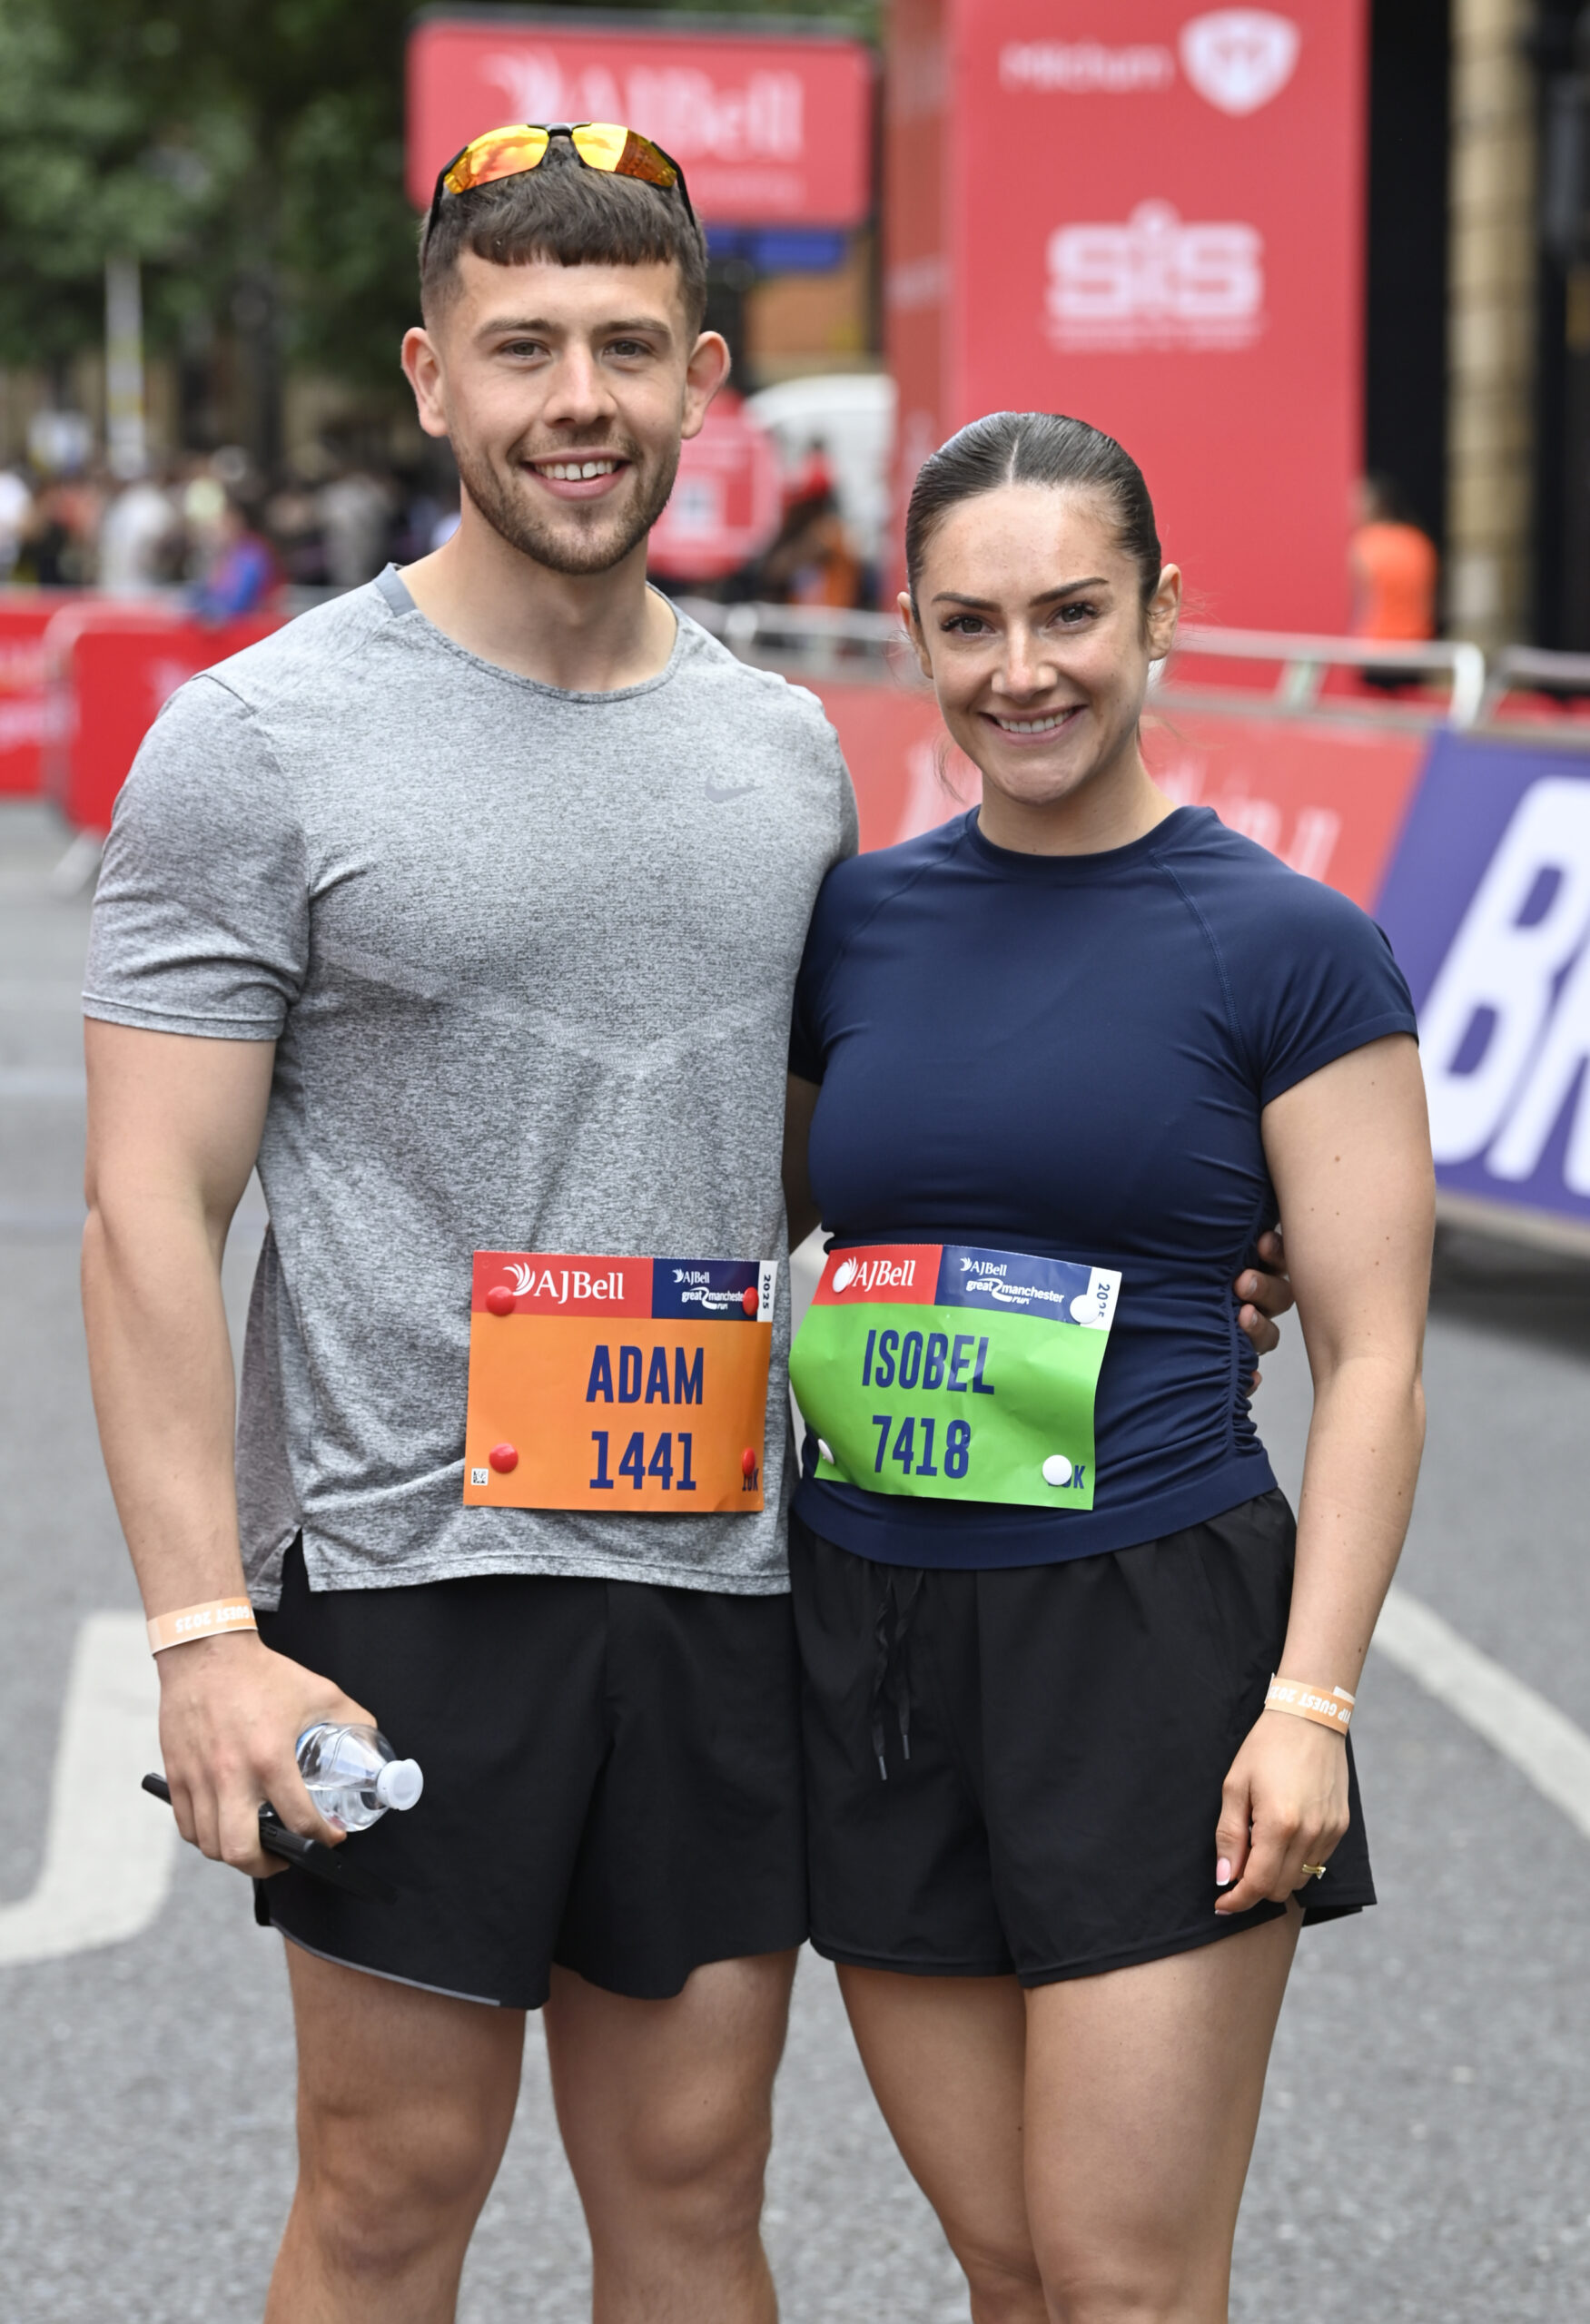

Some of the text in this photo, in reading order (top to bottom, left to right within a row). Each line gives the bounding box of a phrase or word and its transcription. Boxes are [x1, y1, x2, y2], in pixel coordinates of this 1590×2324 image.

[683, 1271, 710, 1285] AJBell
[854, 1260, 916, 1292] AJBell
[970, 1261, 1008, 1276] AJBell
[533, 1269, 625, 1305] AJBell
[682, 1290, 744, 1303] great mancheste
[763, 1275, 772, 1309] 2025
[966, 1280, 1064, 1304] great manchester
[1012, 1295, 1030, 1305] run
[586, 1344, 704, 1404] ADAM
[862, 1329, 995, 1395] ISOBEL
[872, 1414, 972, 1479] 7418
[589, 1431, 696, 1491] 1441
[176, 1610, 212, 1632] 2025
[216, 1605, 250, 1622] GUEST
[1269, 1686, 1297, 1702] 202
[1298, 1692, 1338, 1717] GUEST
